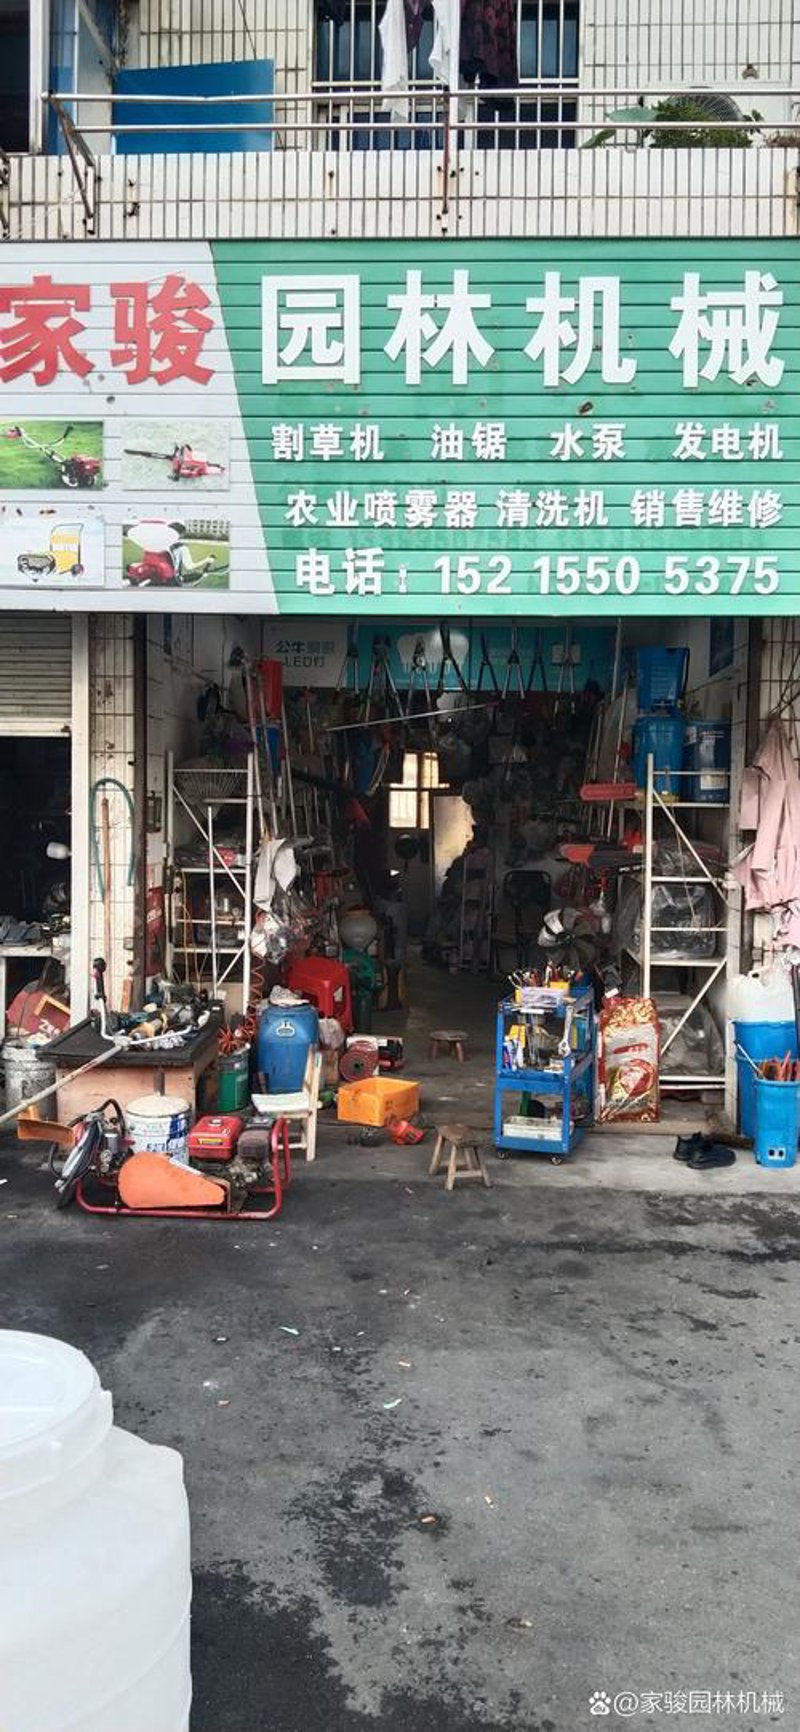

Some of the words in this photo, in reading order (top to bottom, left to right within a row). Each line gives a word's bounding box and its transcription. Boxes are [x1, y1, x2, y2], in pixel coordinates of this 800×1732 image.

[0, 274, 214, 386] 家骏
[261, 269, 785, 388] 园林机械
[271, 422, 385, 461] 割草机
[430, 421, 508, 461] 油锯
[549, 422, 627, 461] 水泵
[672, 421, 784, 461] 发电机
[285, 489, 478, 528] 农业喷雾器
[495, 489, 609, 528] 清洗机
[630, 488, 784, 528] 销售维修
[433, 554, 513, 595] 152
[533, 554, 641, 595] 1550
[663, 554, 780, 595] 5375
